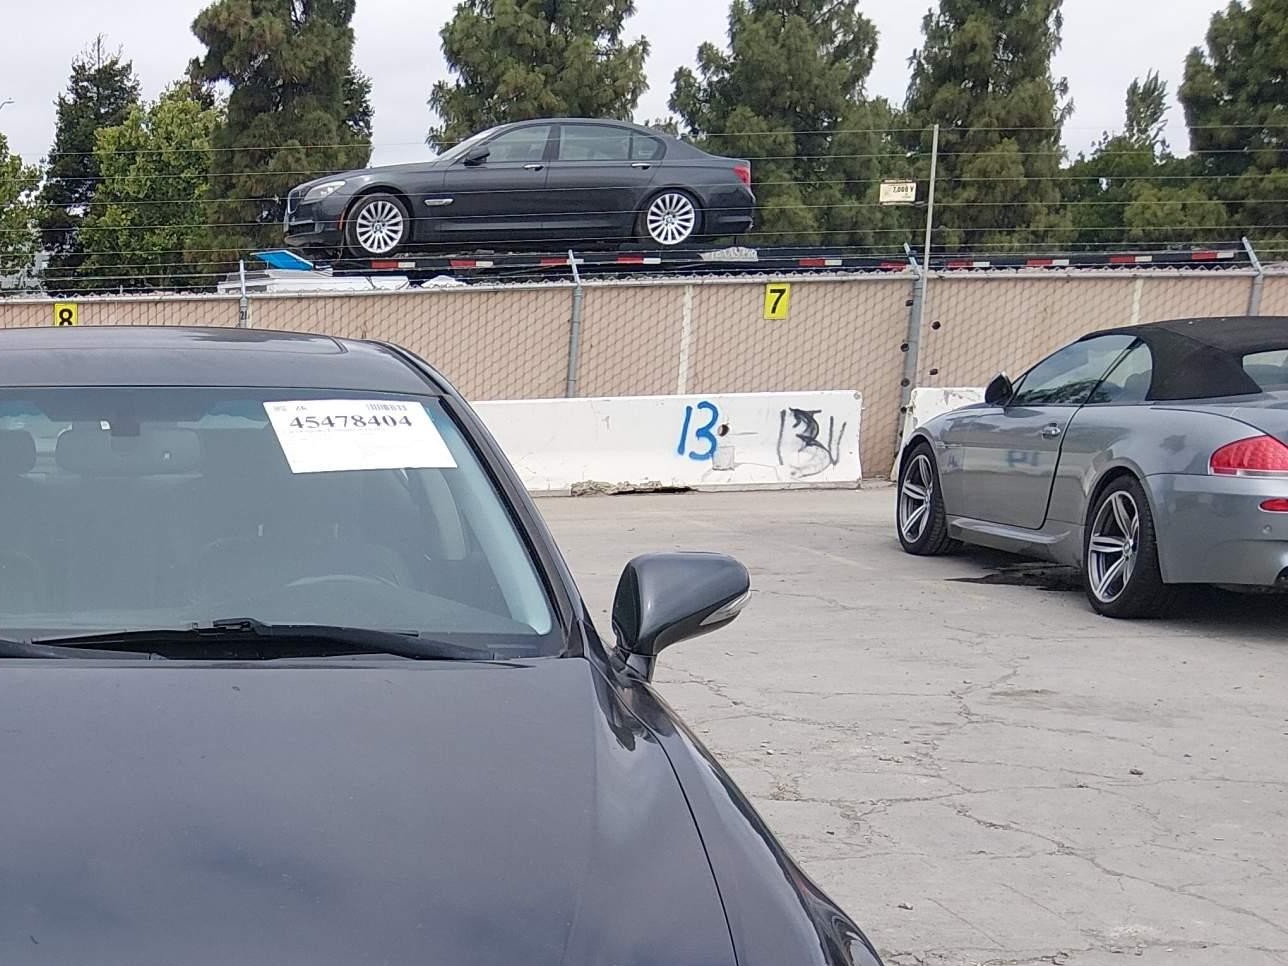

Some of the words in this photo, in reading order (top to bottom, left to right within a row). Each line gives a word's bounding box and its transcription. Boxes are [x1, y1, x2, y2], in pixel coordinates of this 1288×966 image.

[770, 288, 786, 314] 7
[59, 308, 73, 326] 8
[289, 415, 413, 429] 45478404
[677, 400, 719, 460] 13
